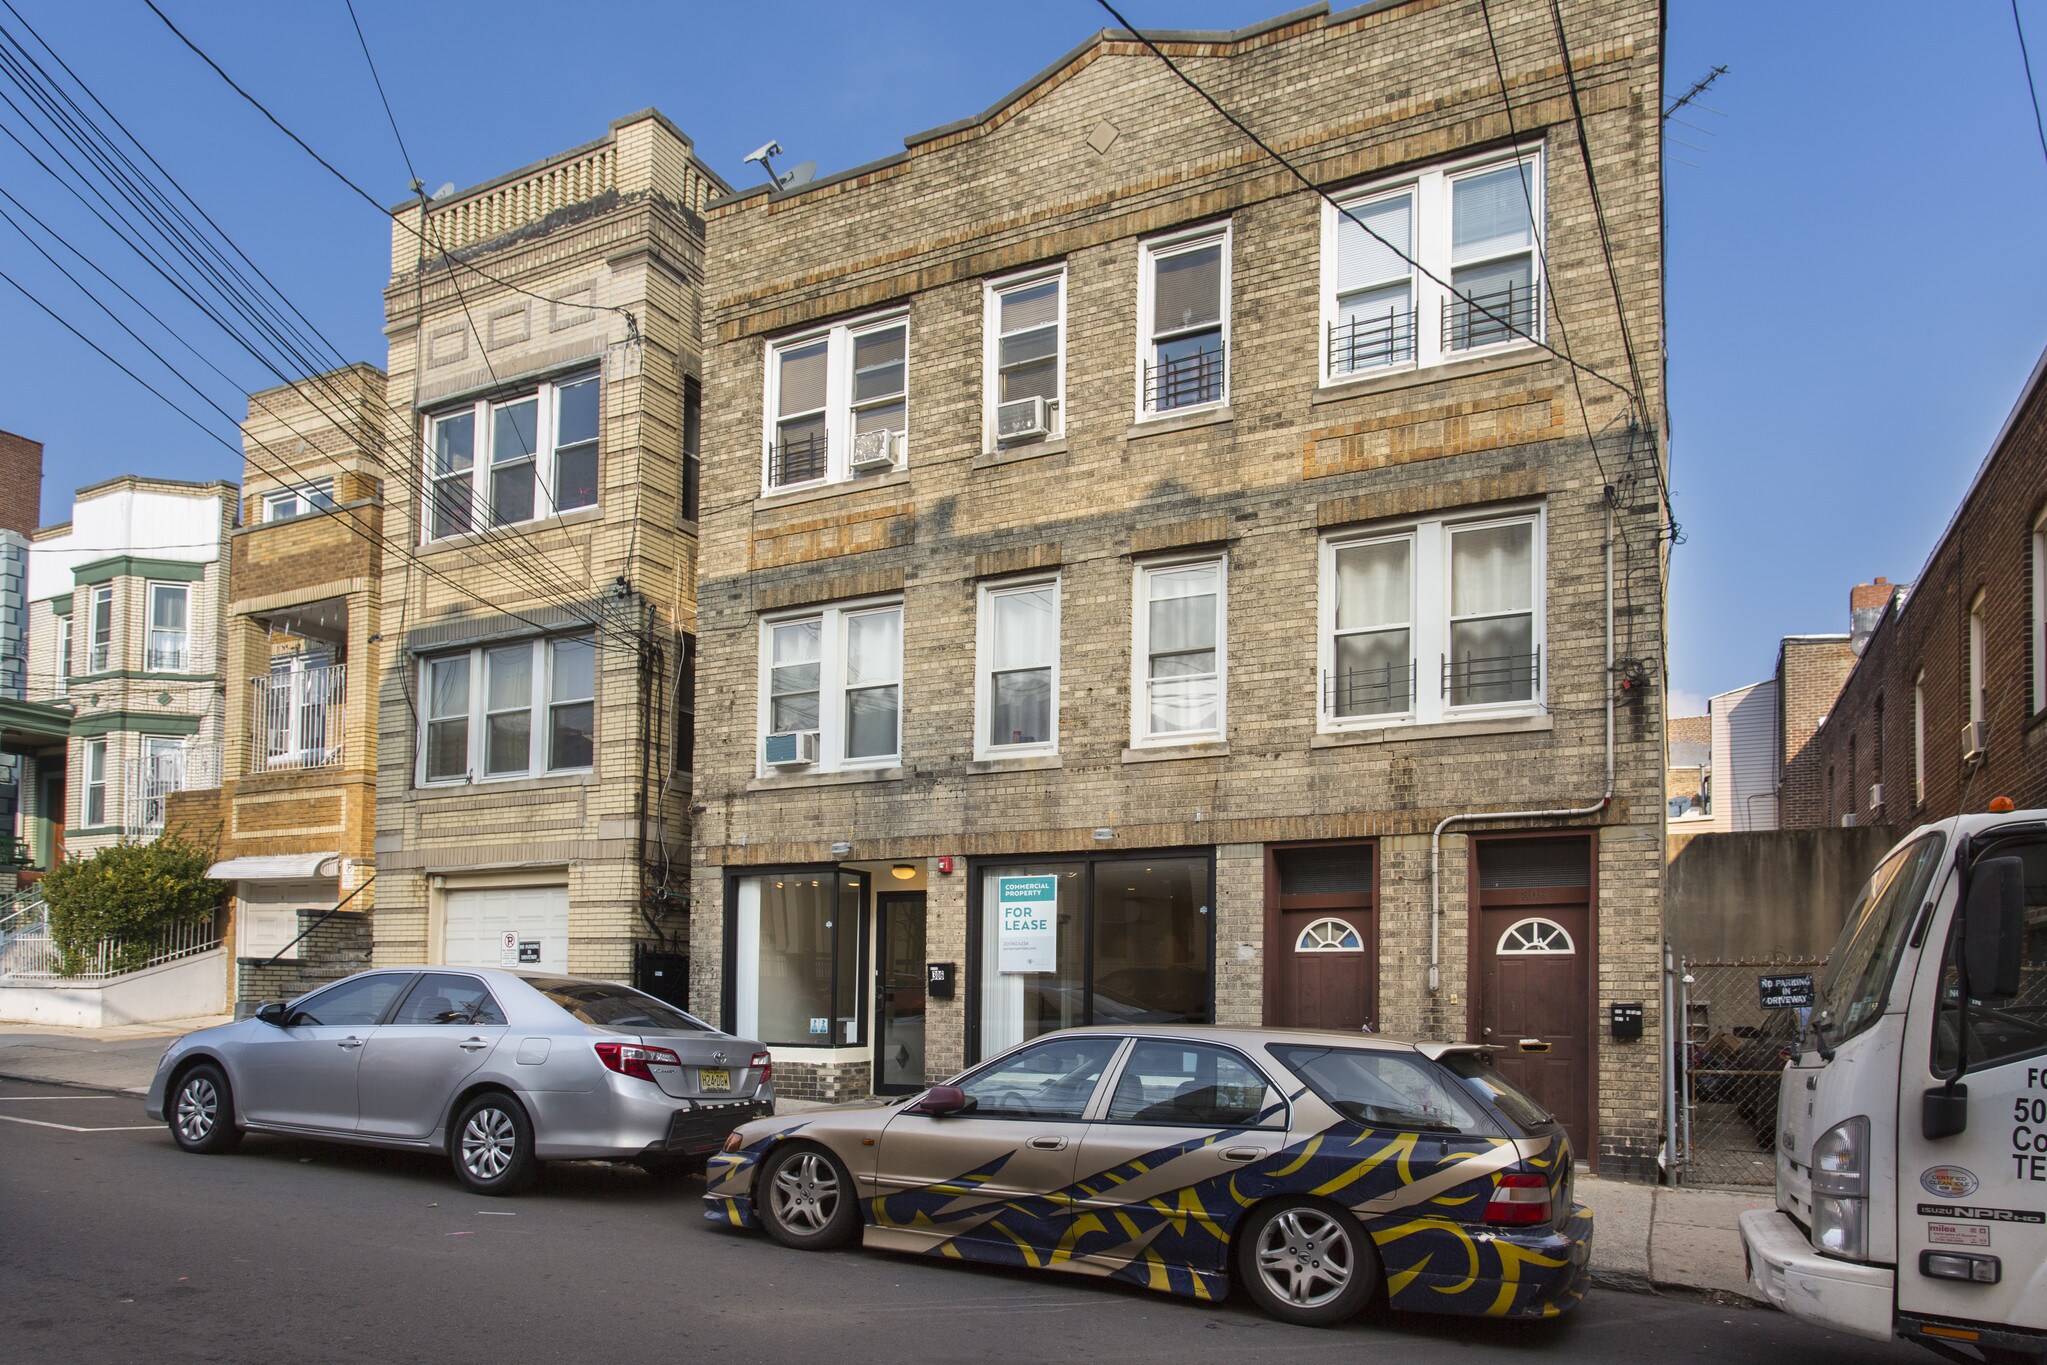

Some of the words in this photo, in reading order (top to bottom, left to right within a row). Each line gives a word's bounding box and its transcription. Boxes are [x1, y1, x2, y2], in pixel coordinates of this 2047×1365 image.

[1005, 908, 1032, 917] FOR
[1005, 920, 1047, 930] LEASE
[932, 971, 944, 980] 306
[1775, 978, 1810, 987] PARKING
[1767, 995, 1807, 1004] DRIVEWAY
[1954, 1208, 2014, 1220] NPR
